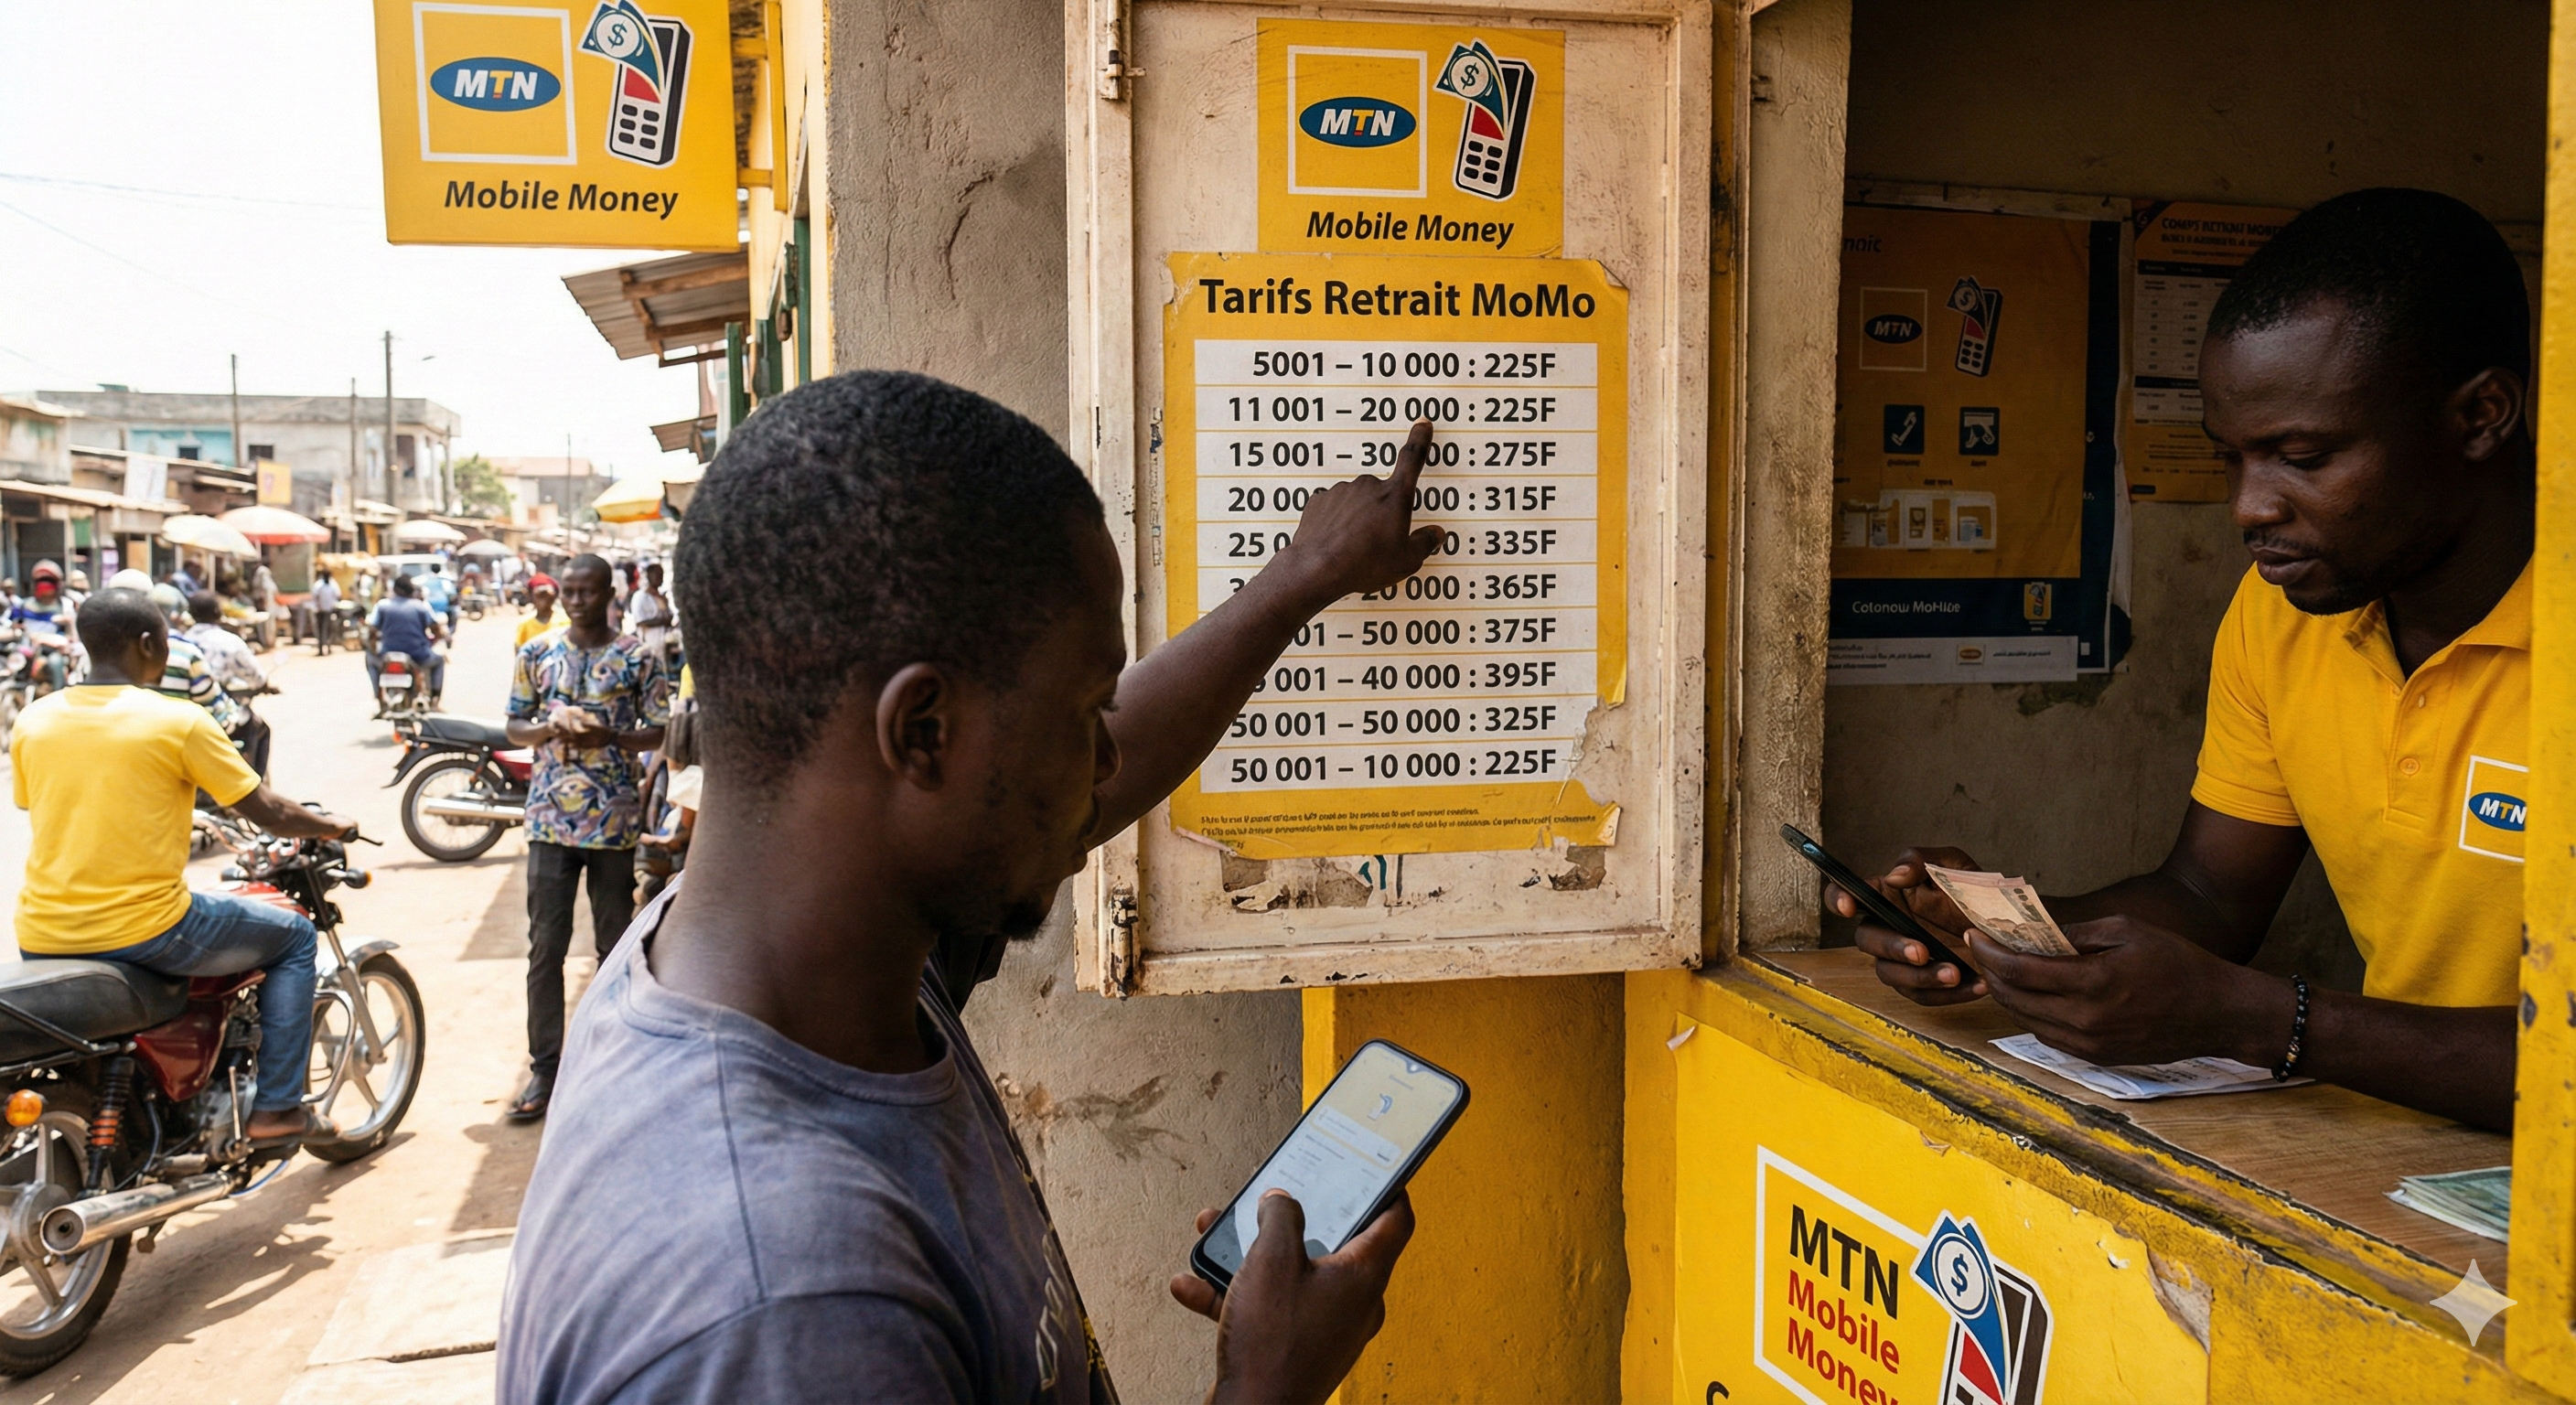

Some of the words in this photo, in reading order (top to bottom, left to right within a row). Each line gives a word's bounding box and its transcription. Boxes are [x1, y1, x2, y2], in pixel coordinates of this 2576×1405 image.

[454, 69, 538, 101] MTN
[1319, 108, 1397, 137] MTN
[445, 180, 559, 210] Mobile
[567, 183, 679, 220] Money
[1306, 210, 1408, 241] Mobile
[1415, 214, 1515, 251] Money
[1198, 277, 1313, 315] Tarifs
[1325, 280, 1461, 316] Retrait
[1472, 283, 1596, 319] MoMo
[1873, 320, 1913, 338] MTN
[1252, 351, 1324, 377] 5001
[1362, 352, 1397, 378] 10
[1404, 352, 1460, 378] 000
[1484, 352, 1556, 379] 225F
[1229, 397, 1260, 422] 11
[1272, 396, 1324, 422] 001
[1359, 397, 1397, 423] 20
[1404, 397, 1460, 423] 000
[1484, 397, 1556, 423] 225F
[1229, 442, 1264, 467] 15
[1272, 442, 1324, 467] 001
[1360, 441, 1398, 467] 30
[1425, 442, 1460, 467] 00
[1484, 441, 1557, 467] 275F
[1228, 487, 1265, 512] 20
[1272, 487, 1328, 512] 00
[1485, 486, 1556, 511] 315F
[1229, 532, 1265, 557] 25
[1484, 529, 1557, 555] 335F
[1405, 574, 1460, 601] 000
[1484, 574, 1557, 600] 365F
[1361, 620, 1398, 646] 50
[1405, 619, 1460, 646] 000
[1485, 617, 1557, 644] 375F
[1274, 666, 1326, 692] 001
[1361, 665, 1398, 691] 40
[1405, 663, 1461, 690] 000
[1484, 661, 1556, 688] 395F
[1230, 713, 1268, 738] 50
[1274, 712, 1326, 737] 001
[1362, 710, 1399, 735] 50
[1406, 707, 1461, 734] 000
[1485, 705, 1556, 732] 325F
[1230, 757, 1268, 783] 50
[1275, 756, 1326, 782] 001
[1364, 754, 1399, 779] 10
[1406, 752, 1461, 778] 000
[1485, 748, 1556, 776] 225F
[2479, 798, 2528, 825] MTN
[1789, 1203, 1899, 1321] MTN
[1787, 1268, 1900, 1375] Mobile
